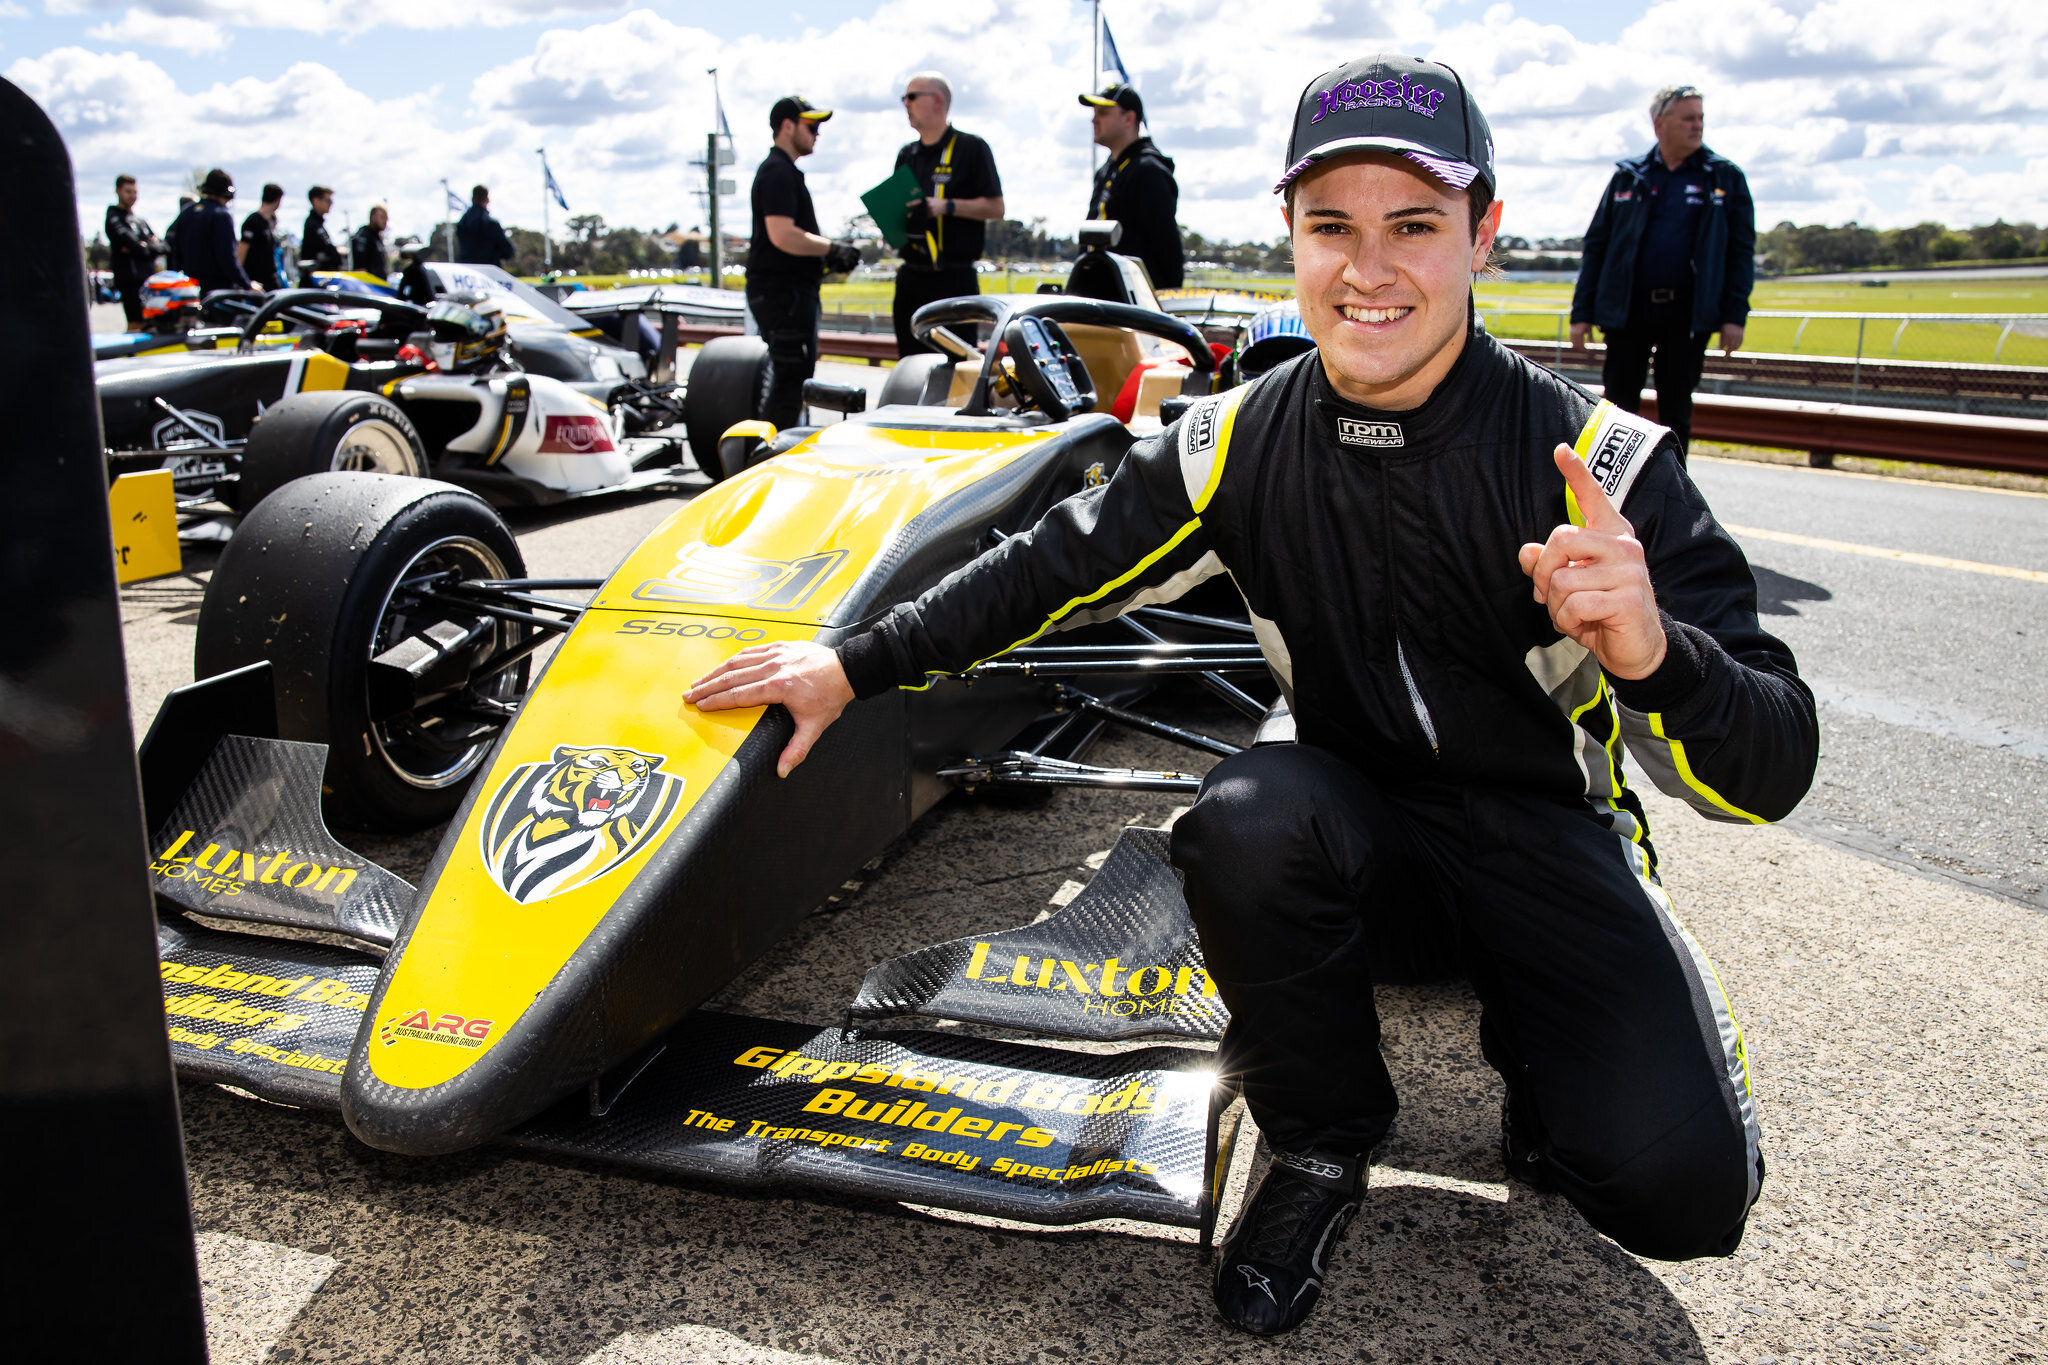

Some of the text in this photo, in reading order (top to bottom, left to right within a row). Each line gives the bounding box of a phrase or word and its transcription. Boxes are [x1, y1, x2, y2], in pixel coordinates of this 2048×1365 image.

[1312, 73, 1445, 124] Hoosier
[1345, 97, 1434, 119] RACING TIRE
[1342, 421, 1399, 437] rpm
[1342, 435, 1402, 446] RACEWEAR
[1591, 428, 1630, 483] rpm
[1606, 432, 1642, 493] RACEWEAR
[631, 541, 850, 613] 31
[615, 619, 767, 642] S5000
[149, 861, 246, 896] HOMES
[159, 830, 358, 894] Luxton
[965, 942, 1217, 999] Luxton
[398, 1010, 495, 1040] ARG
[1083, 998, 1213, 1018] HOMES
[393, 1027, 483, 1048] AUSTRALIAN RACING GROUP
[733, 1046, 1169, 1116] Gippsland Body
[801, 1088, 1060, 1149] Builders
[682, 1109, 1159, 1181] The Transport Body Specialists
